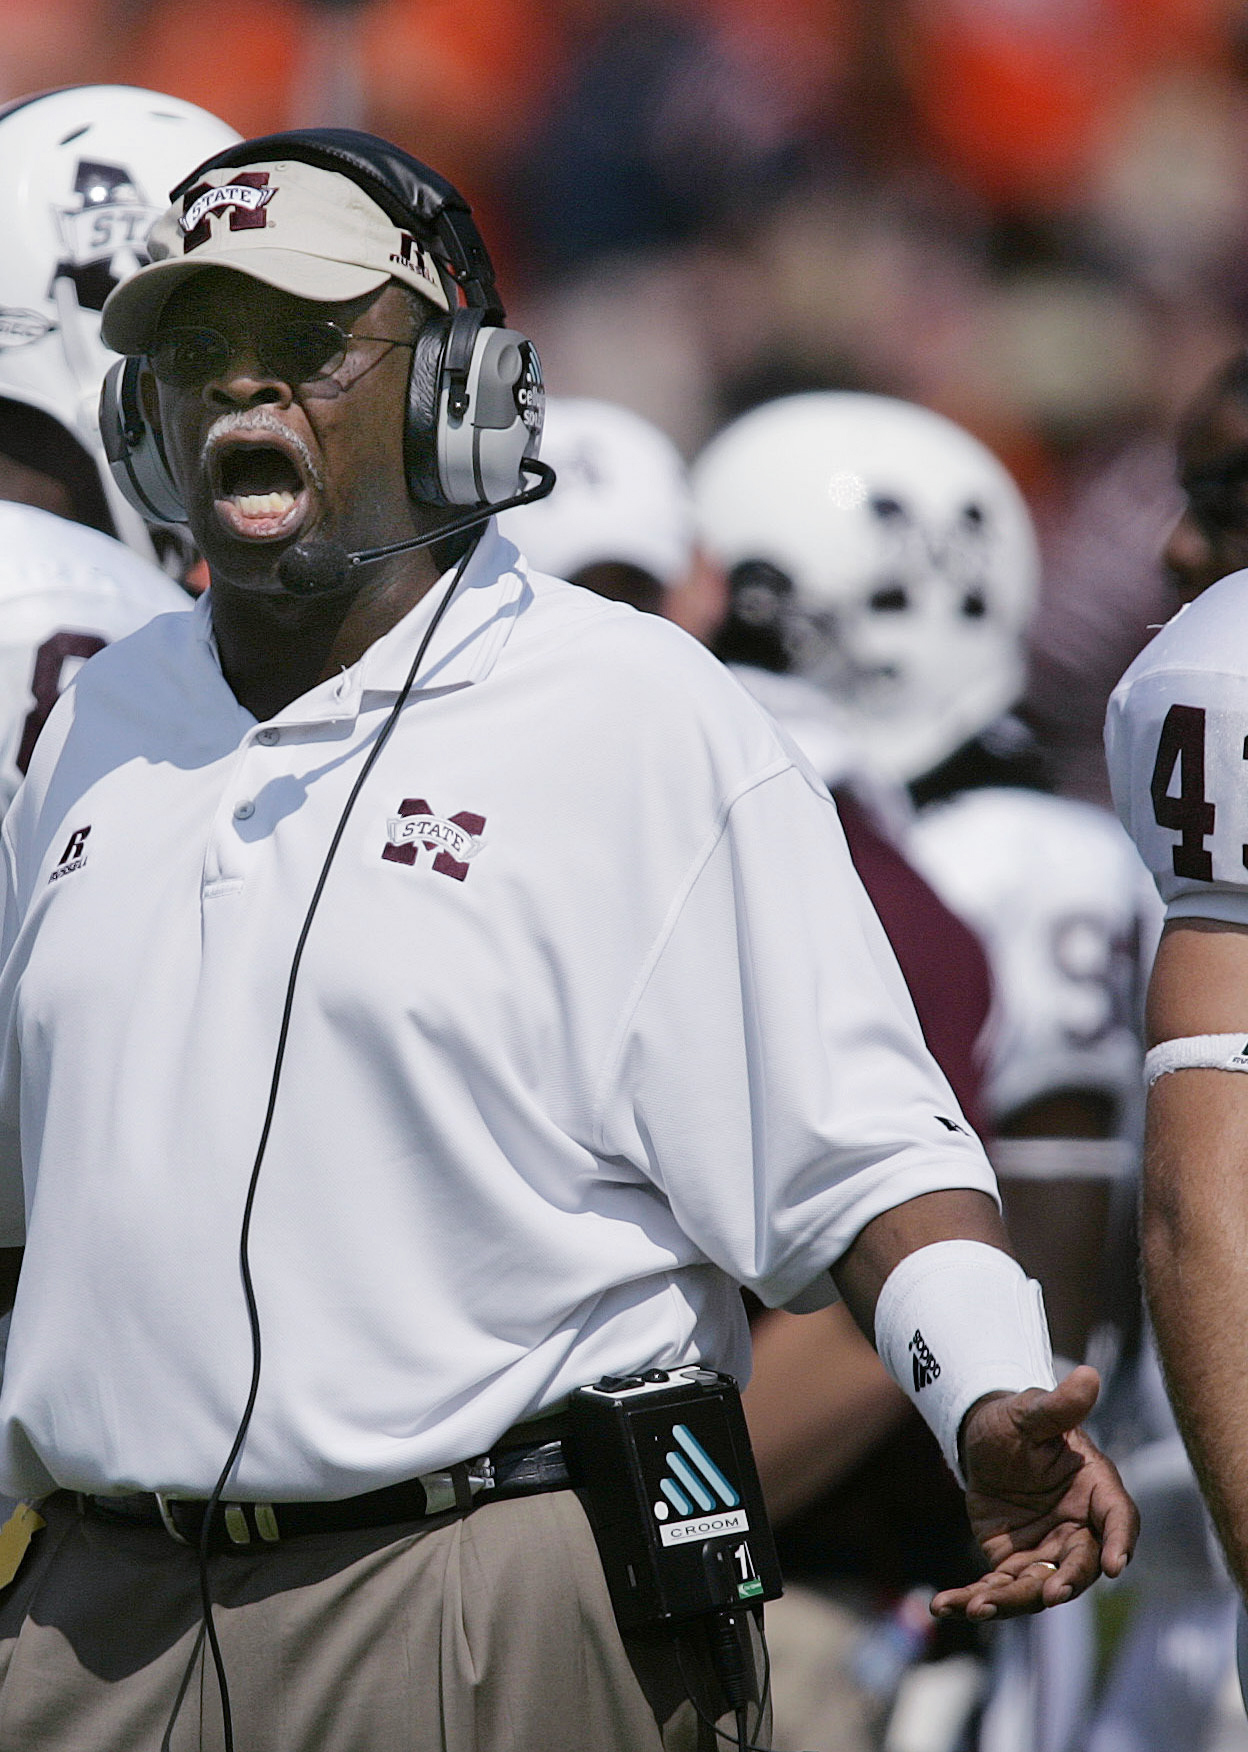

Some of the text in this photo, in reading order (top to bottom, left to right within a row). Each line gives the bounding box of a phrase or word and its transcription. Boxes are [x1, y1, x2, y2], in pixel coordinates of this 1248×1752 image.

[192, 187, 252, 221] STATE
[402, 822, 464, 852] STATE
[913, 1328, 941, 1379] adidas
[671, 1517, 739, 1538] CROOM
[735, 1544, 748, 1580] 1
